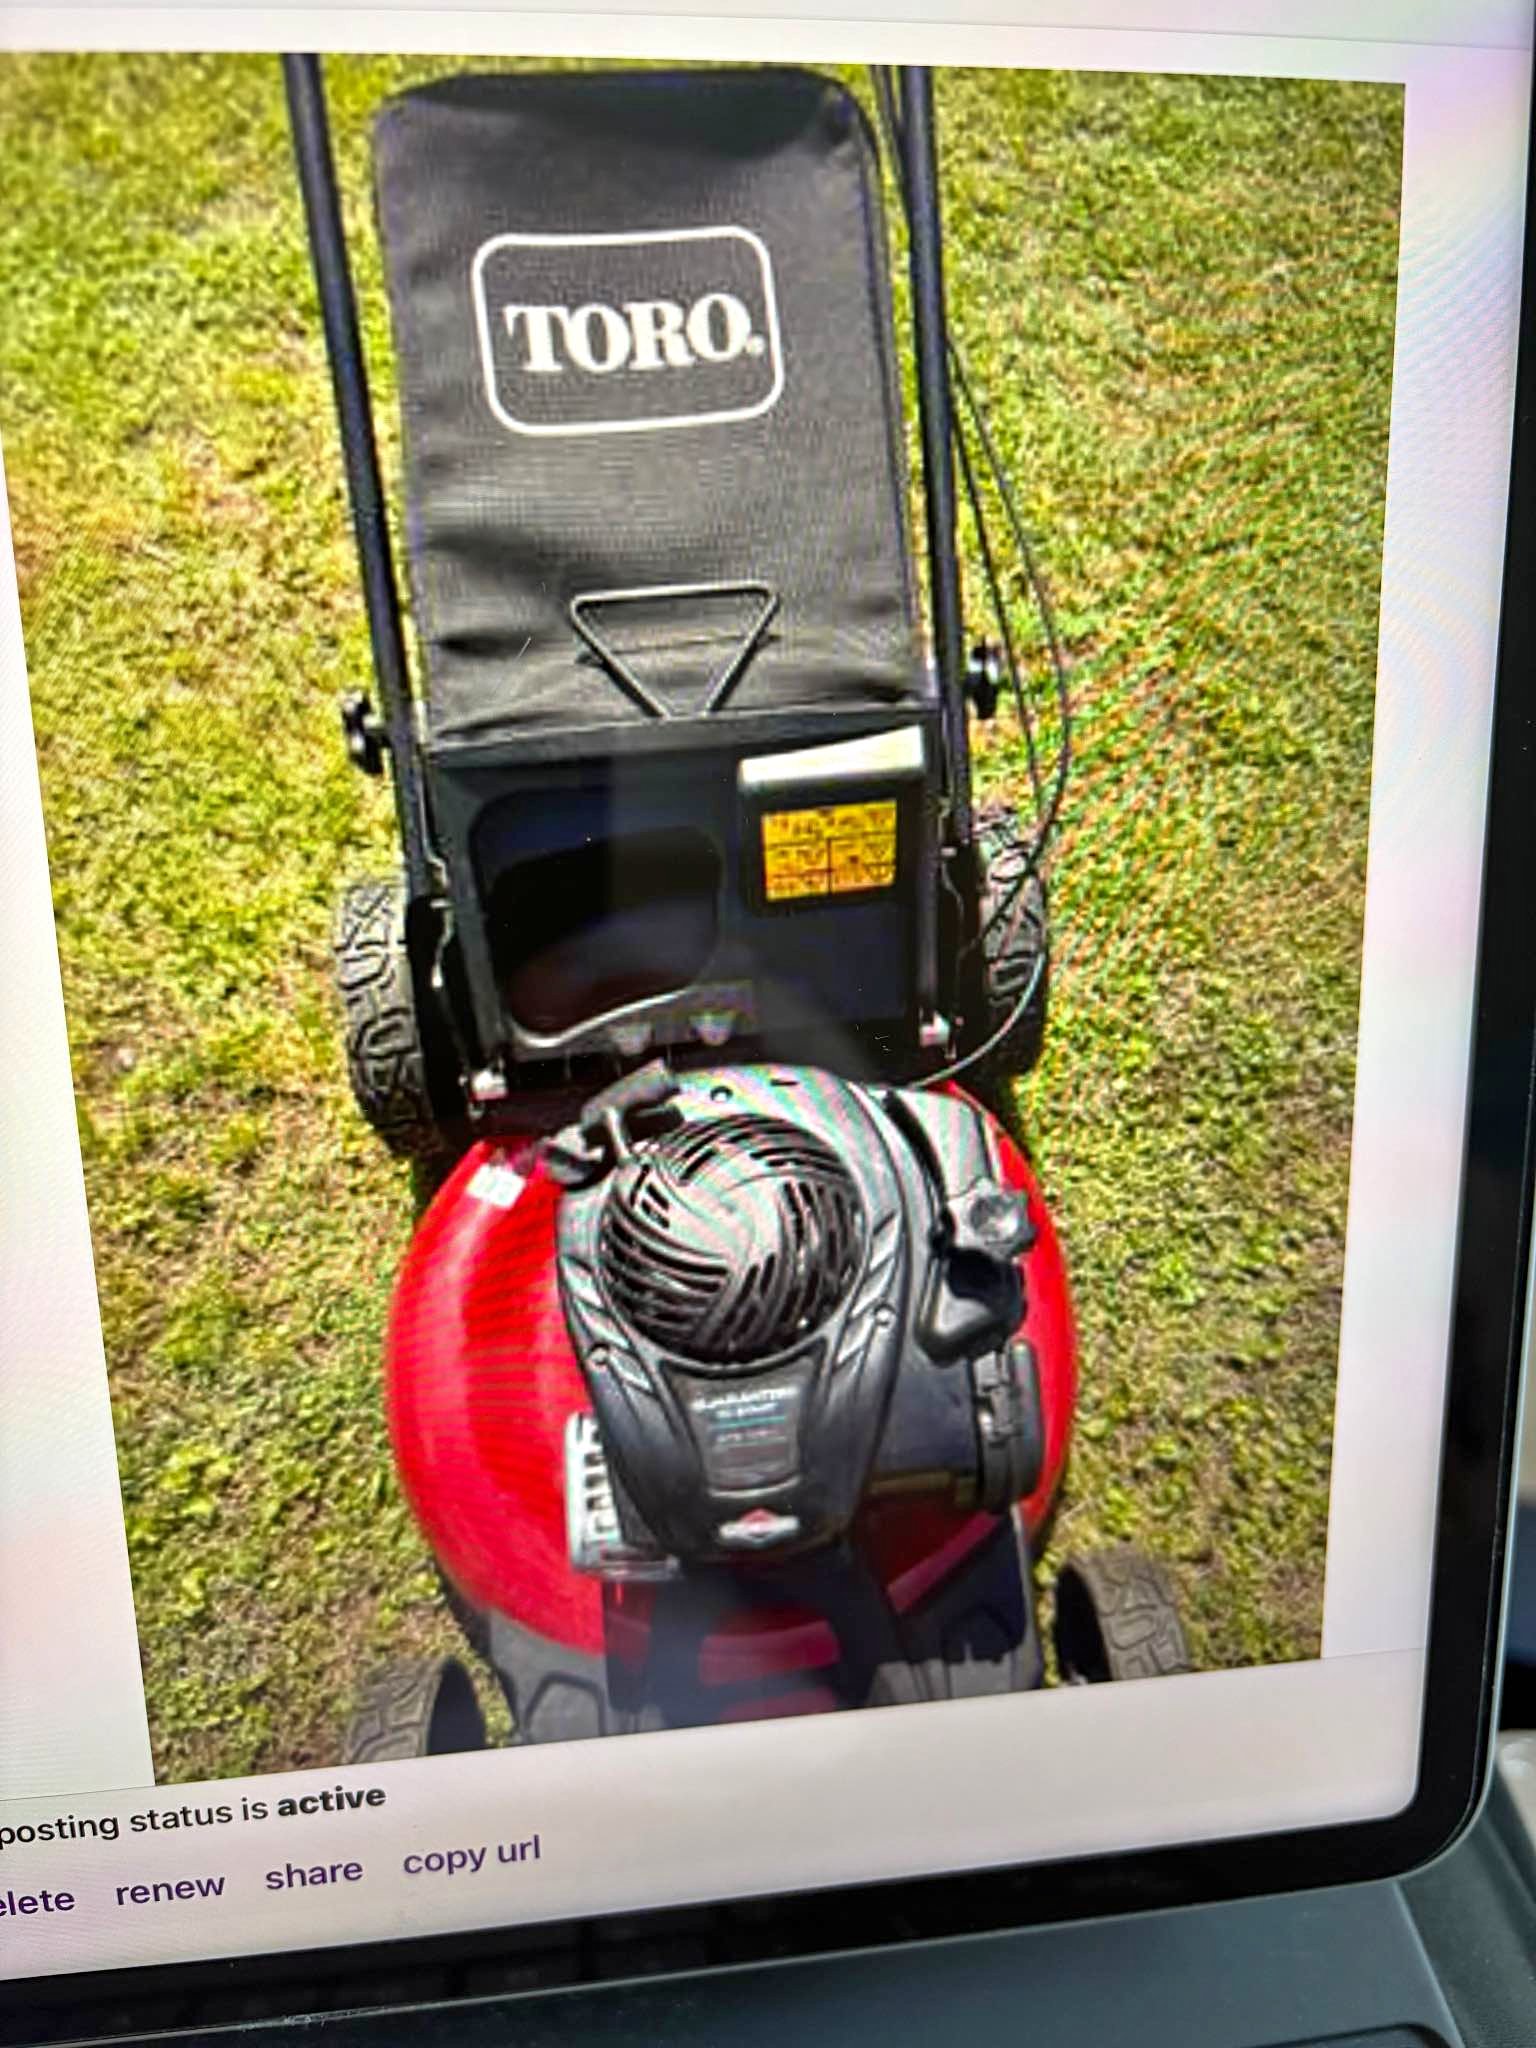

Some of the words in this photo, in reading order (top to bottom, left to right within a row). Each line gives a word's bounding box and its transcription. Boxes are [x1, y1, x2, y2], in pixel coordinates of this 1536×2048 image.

[0, 1814, 120, 1850] posting
[129, 1805, 233, 1832] status
[242, 1797, 269, 1821] is
[277, 1785, 386, 1817] active
[116, 1876, 225, 1905] renew
[265, 1862, 363, 1890] share
[403, 1846, 487, 1875] copy
[498, 1834, 541, 1863] url
